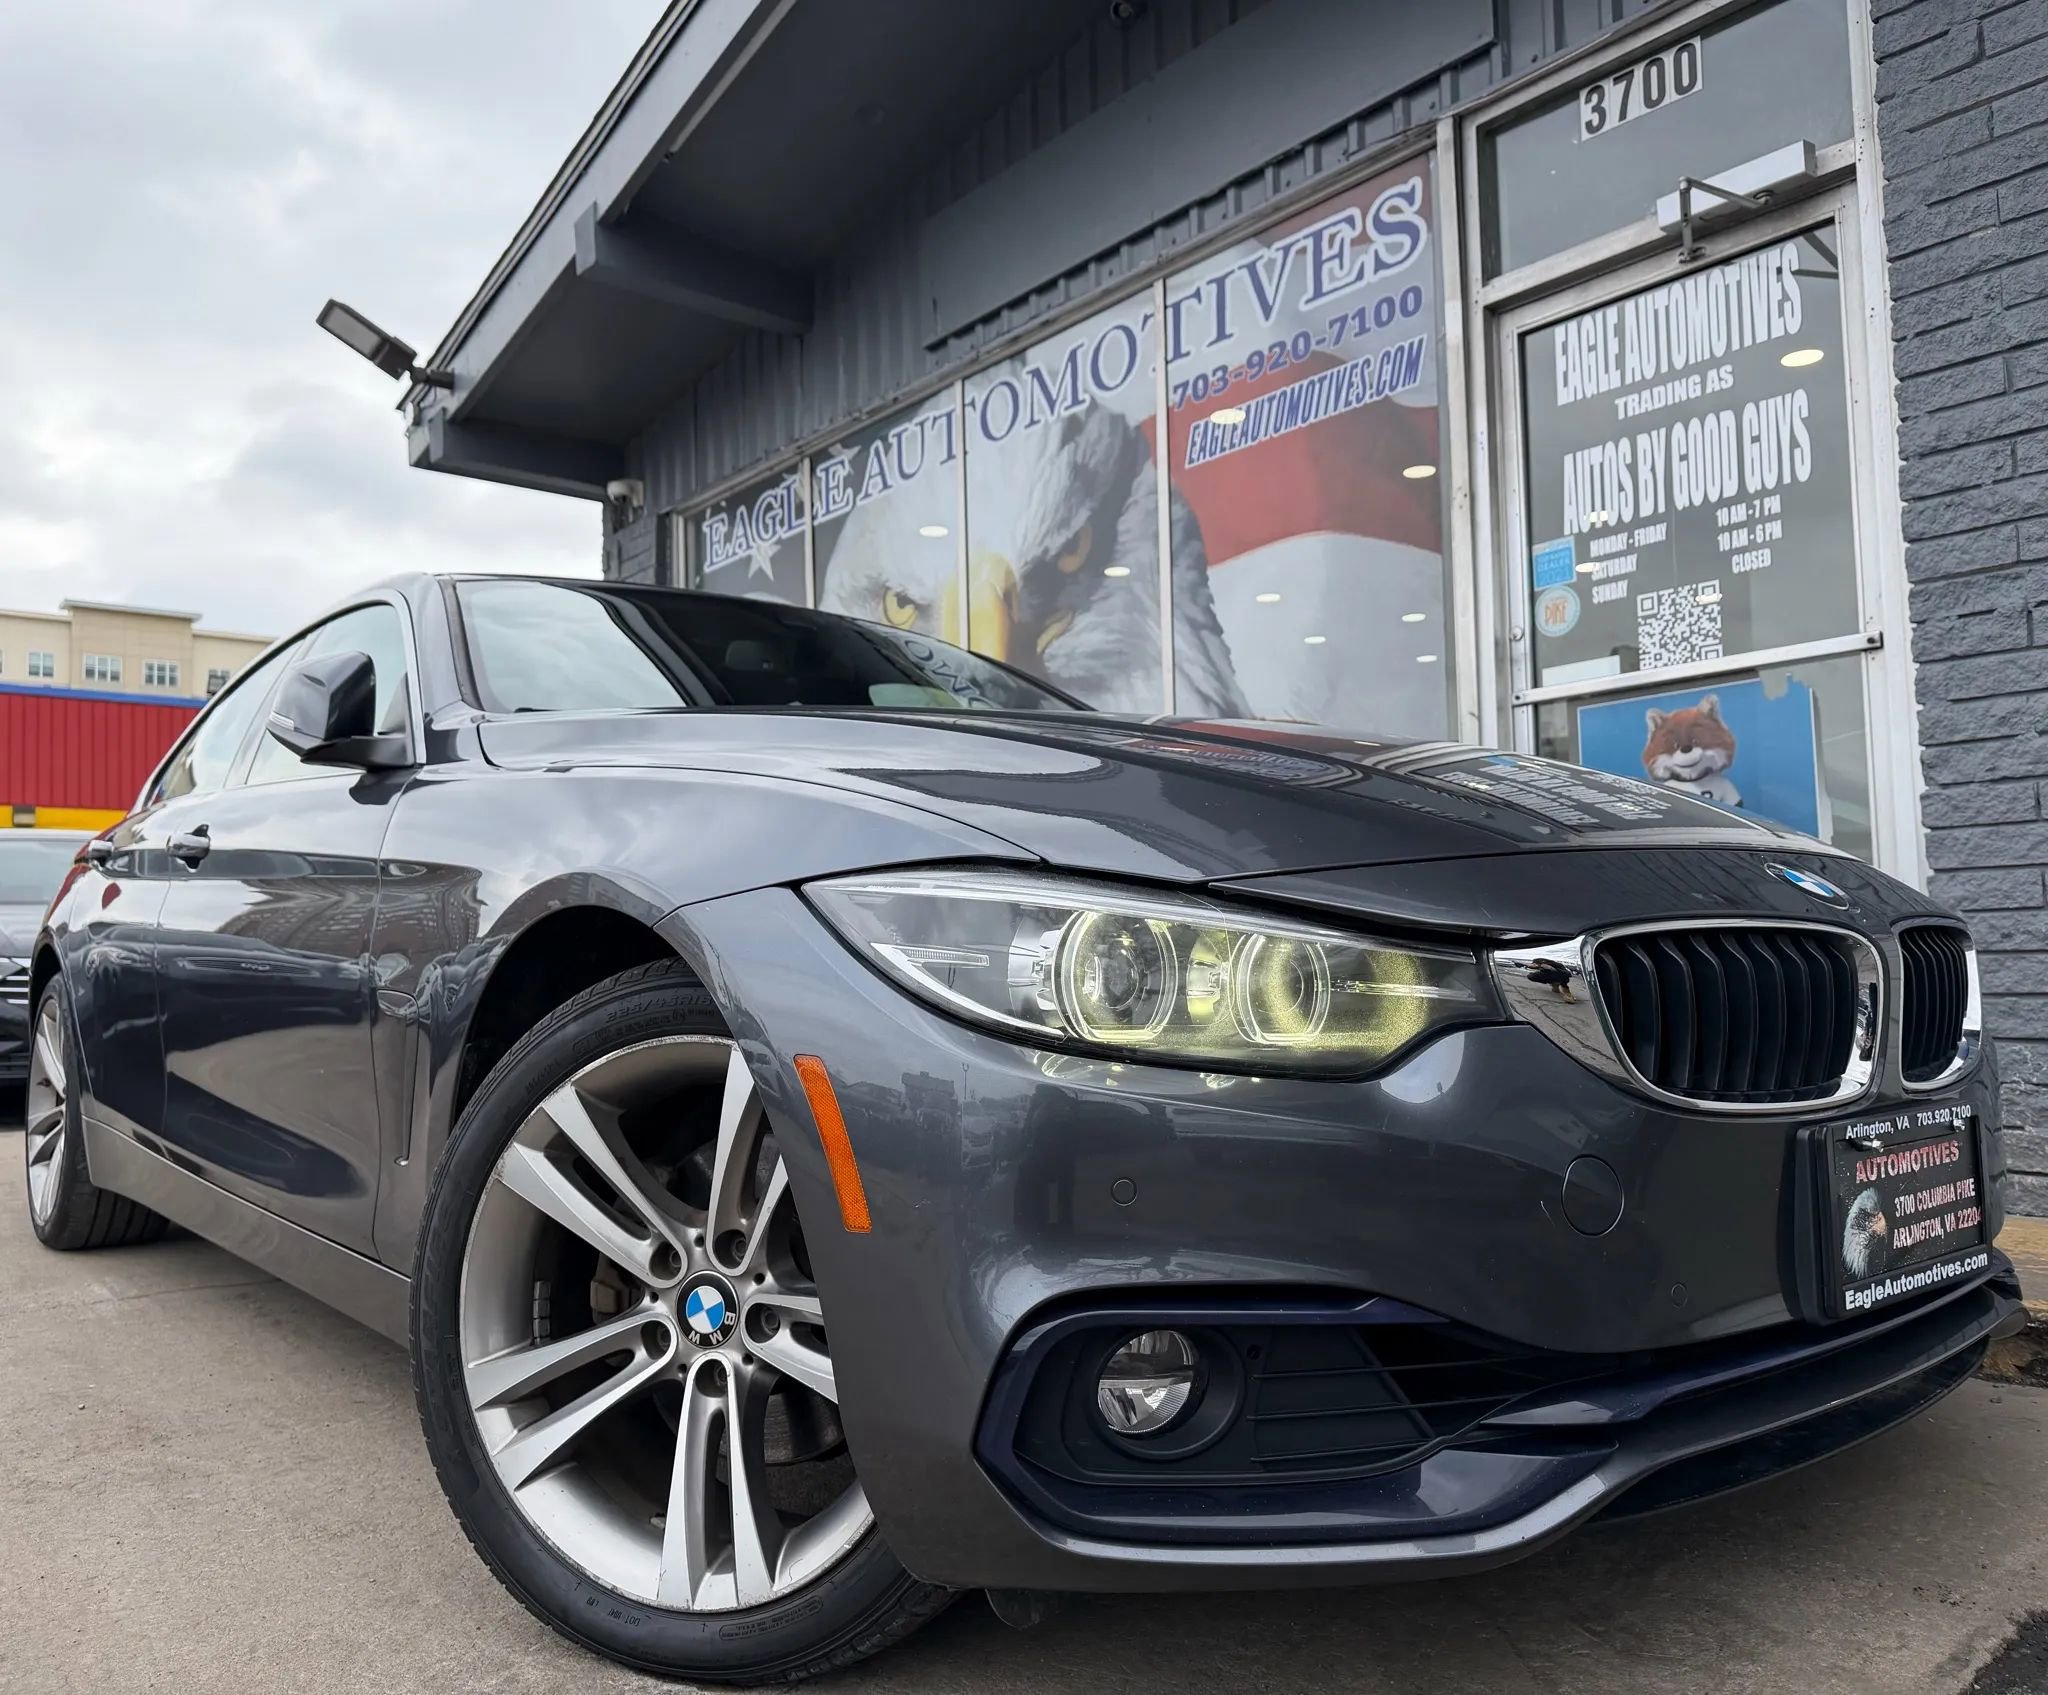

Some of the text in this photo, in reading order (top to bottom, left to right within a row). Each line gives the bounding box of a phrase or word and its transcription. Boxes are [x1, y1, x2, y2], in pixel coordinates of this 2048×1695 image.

[1584, 42, 1699, 135] 3700
[1554, 242, 1802, 406] EAGLE AUTOMOTIVES
[1173, 285, 1424, 411] 703-920-7100
[702, 175, 1428, 574] EAGLE AUTOMOTIVES
[1614, 364, 1734, 420] TRADING AS
[1185, 334, 1428, 469] EAGLEAUTOMOTIVES.COM
[1563, 388, 1812, 536] AUTOS BY GOOD GUYS
[1716, 507, 1730, 527] 10
[1730, 502, 1748, 525] AM
[1753, 499, 1761, 519] 7
[1763, 494, 1781, 516] PM
[1590, 532, 1628, 558] MONDAY
[1634, 522, 1667, 547] FRIDAY
[1717, 532, 1731, 552] 10
[1731, 527, 1749, 549] AM
[1755, 524, 1764, 544] 6
[1764, 519, 1782, 542] PM
[1592, 553, 1638, 581] SATURDAY
[1731, 548, 1772, 574] CLOSED
[1592, 579, 1628, 604] SUNDAY
[1845, 1105, 1971, 1140] Arlington, VA 703.920.7100
[1855, 1139, 1960, 1184] AUTOMOTIVES
[1894, 1178, 1976, 1217] 3700 COLUMBIA PIKE
[1893, 1216, 1945, 1249] ARLINGTON,
[1944, 1212, 1957, 1233] VA
[1845, 1252, 1988, 1310] EagleAutomotives.com
